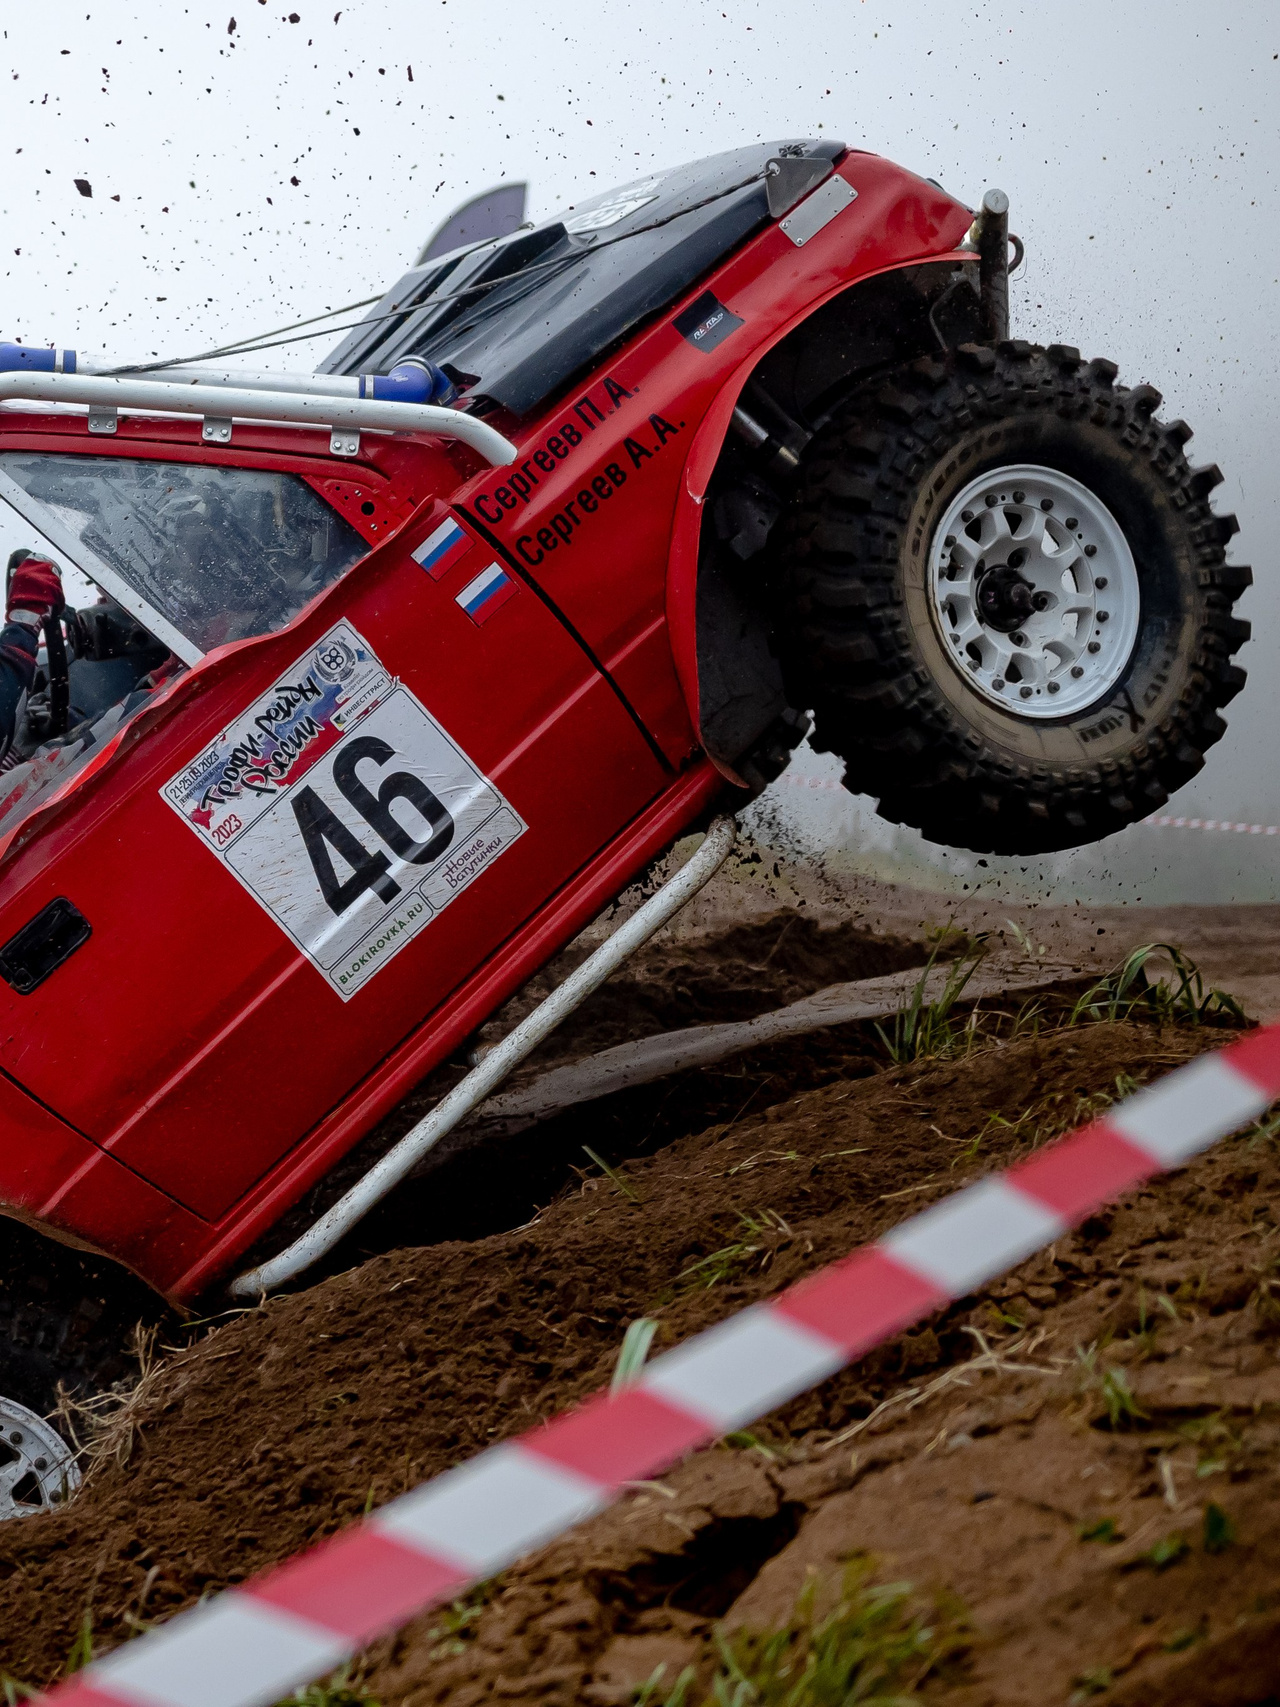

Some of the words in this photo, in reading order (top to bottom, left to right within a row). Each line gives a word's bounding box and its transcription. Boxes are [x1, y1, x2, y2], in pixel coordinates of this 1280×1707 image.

[474, 424, 582, 524] Сергеев
[574, 376, 640, 431] П.А.
[515, 461, 627, 566] Сергеев
[623, 413, 686, 470] А.А.
[343, 677, 386, 717] ИНВЕСТТРАСТ
[169, 750, 220, 800] 21-25.09.2023
[200, 673, 323, 807] Трофи-рейды
[238, 714, 324, 797] России
[211, 813, 243, 846] 2023
[290, 735, 456, 918] 46
[443, 837, 485, 878] Новые
[446, 836, 503, 889] Ватутинки
[338, 902, 425, 985] BLOKIROVKA.RU
